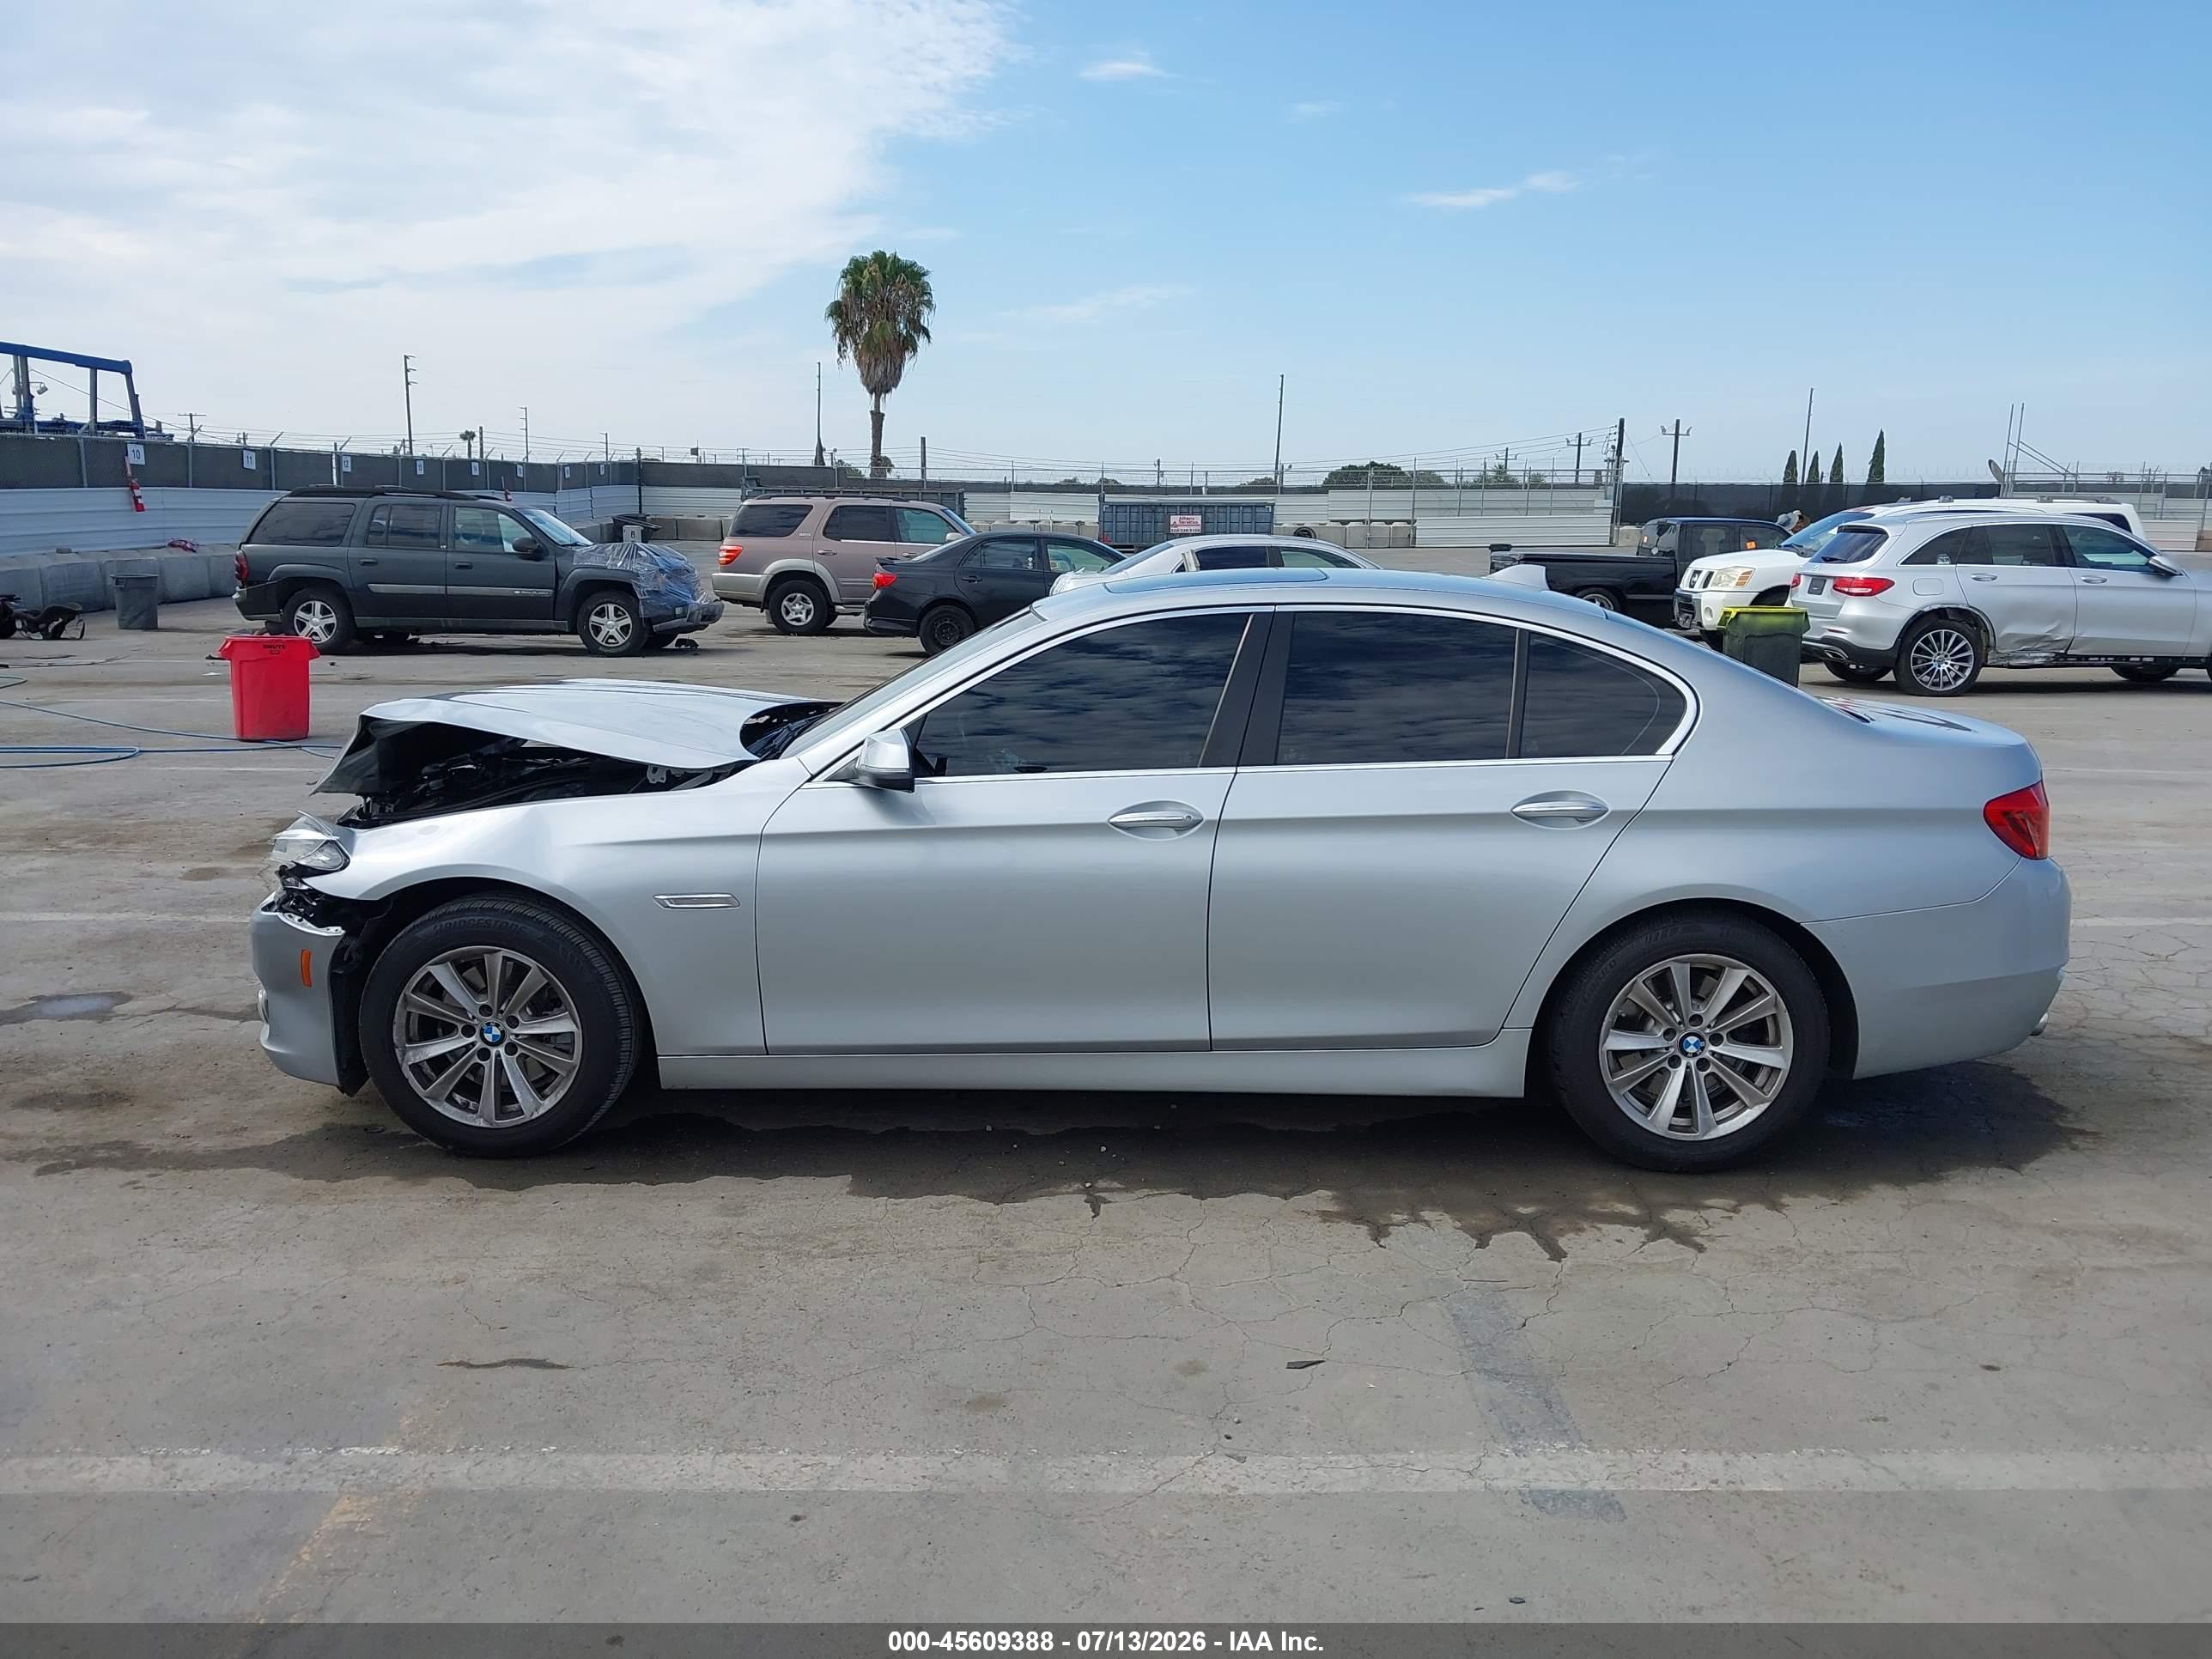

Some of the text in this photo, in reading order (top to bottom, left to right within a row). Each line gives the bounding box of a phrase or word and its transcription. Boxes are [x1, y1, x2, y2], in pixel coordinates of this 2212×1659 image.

[131, 448, 141, 460] 10
[246, 455, 252, 466] 11
[343, 459, 349, 468] 12
